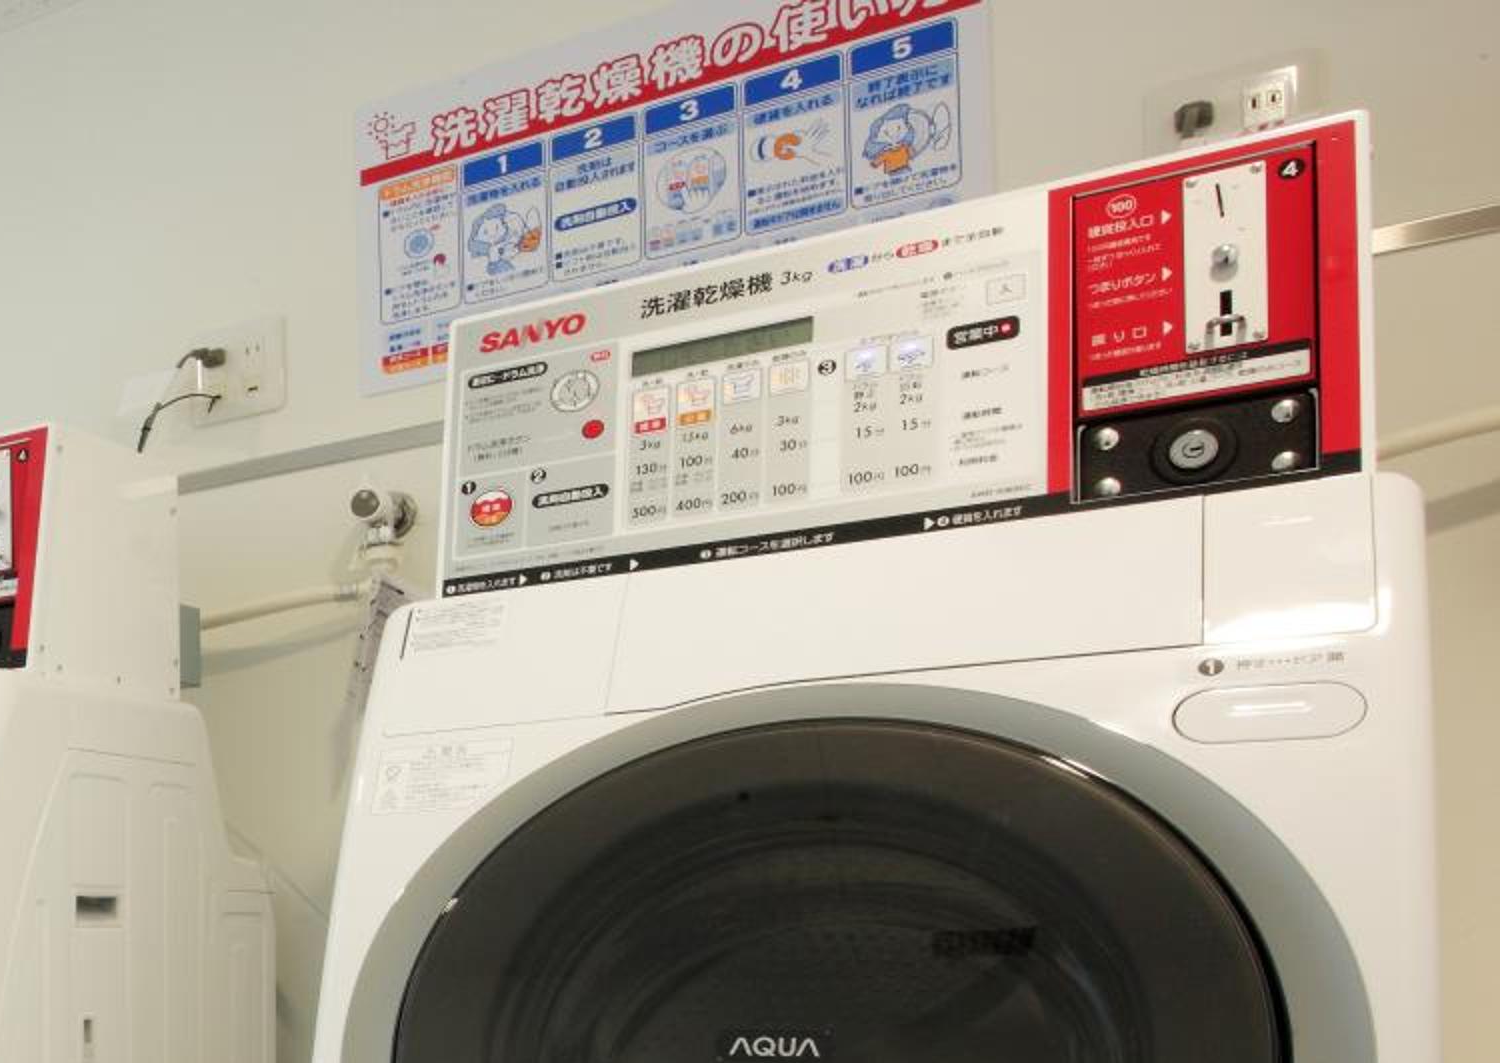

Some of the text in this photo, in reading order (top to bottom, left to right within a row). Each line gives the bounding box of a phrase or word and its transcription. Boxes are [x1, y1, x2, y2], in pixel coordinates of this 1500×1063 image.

[892, 36, 912, 59] 5
[781, 70, 803, 90] 4
[680, 101, 699, 121] 3
[583, 127, 602, 148] 2
[499, 155, 508, 174] 1
[1284, 161, 1300, 177] 4
[640, 271, 813, 319] 洗濯乾燥機 3kg
[479, 313, 587, 353] SANYO
[728, 1036, 820, 1057] AQUA
